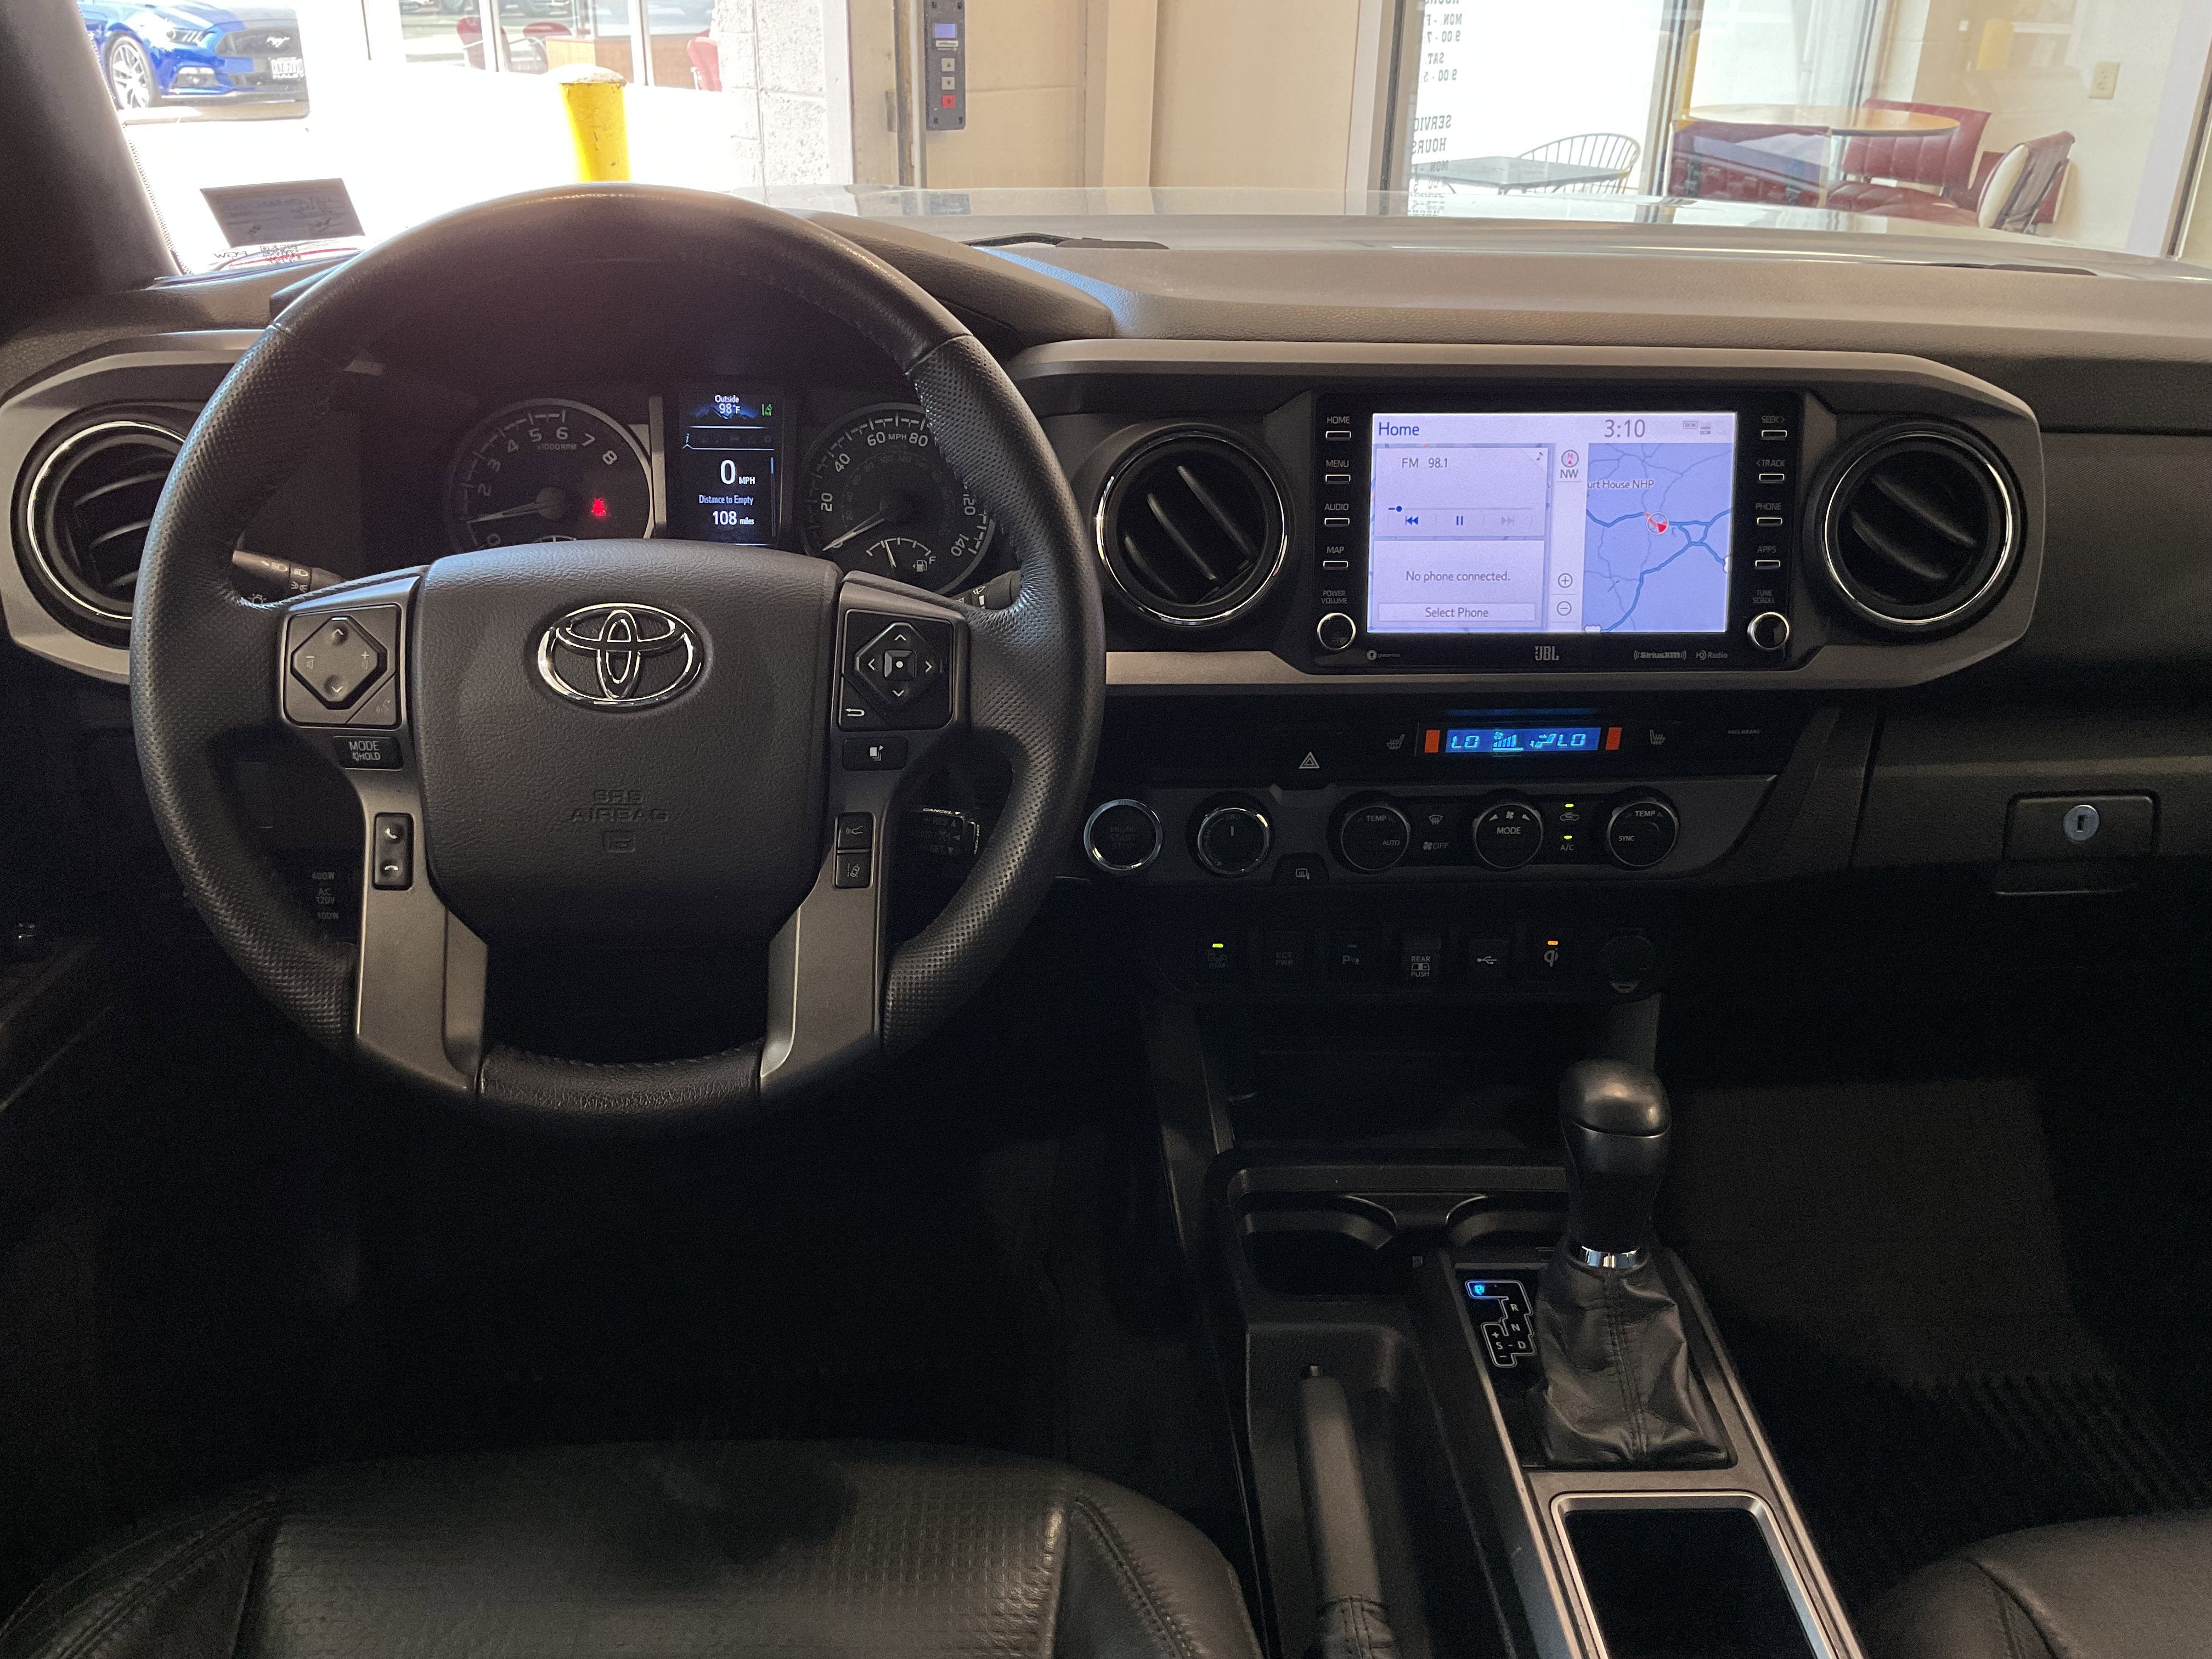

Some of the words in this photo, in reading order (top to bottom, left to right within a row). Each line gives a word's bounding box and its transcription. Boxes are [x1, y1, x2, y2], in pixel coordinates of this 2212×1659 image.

[714, 394, 740, 403] Outside
[719, 403, 741, 414] 98°F
[1327, 416, 1350, 424] HOME
[529, 427, 542, 442] 5
[556, 426, 568, 439] 6
[1379, 422, 1420, 437] Home
[1604, 419, 1646, 438] 3:10
[582, 433, 595, 447] 7
[867, 431, 886, 447] 60
[909, 432, 928, 447] 80
[507, 439, 519, 453] 4
[602, 450, 618, 465] 8
[834, 453, 850, 472] 40
[1402, 458, 1419, 468] FM
[1427, 458, 1448, 468] 98.1
[487, 458, 502, 472] 3
[720, 460, 736, 484] 0
[738, 476, 755, 484] MPH
[1560, 469, 1578, 479] NW
[477, 484, 492, 496] 2
[1587, 480, 1600, 489] urt
[1602, 480, 1630, 489] House
[1632, 480, 1655, 489] NHP
[698, 494, 725, 504] Distance
[726, 496, 733, 504] to
[733, 494, 754, 506] Empty
[821, 492, 833, 512] 20
[713, 511, 737, 525] 108
[950, 533, 969, 557] 140
[929, 556, 937, 565] F
[1406, 571, 1421, 582] No
[1423, 571, 1454, 583] phone
[1456, 571, 1510, 582] connected.
[1425, 607, 1454, 618] Select
[1458, 607, 1489, 618] Phone
[1536, 646, 1559, 661] JBL
[1451, 736, 1480, 748] LO
[1557, 733, 1586, 747] LO
[348, 741, 379, 752] MODE
[359, 752, 381, 761] HOLD
[1497, 826, 1522, 834] MODE
[318, 888, 332, 896] AC
[1510, 1304, 1519, 1312] R
[1496, 1341, 1503, 1350] S
[1517, 1341, 1526, 1349] D
